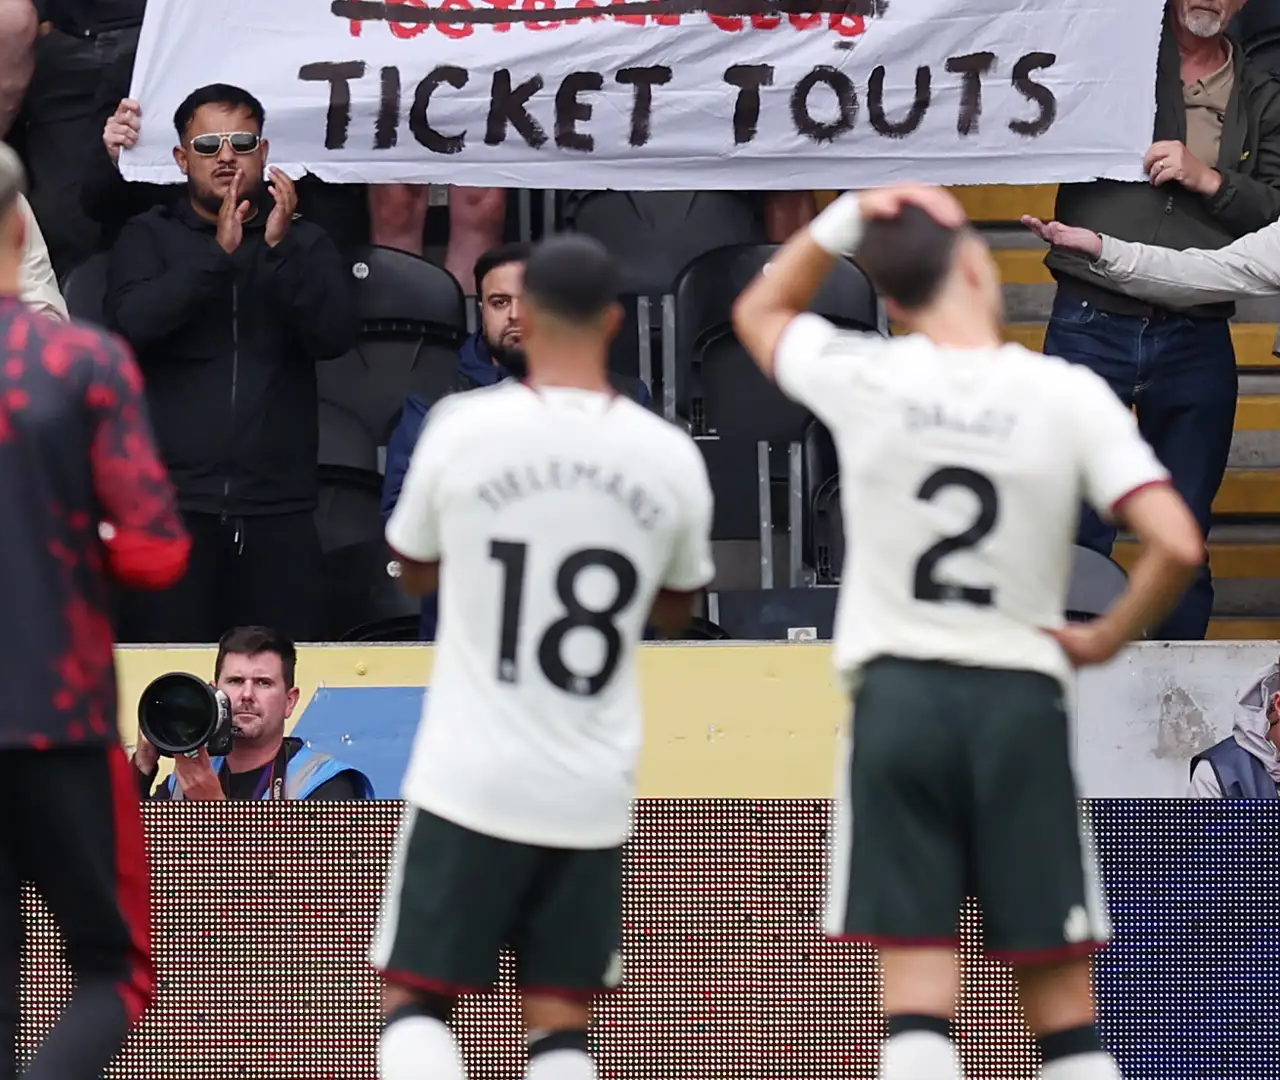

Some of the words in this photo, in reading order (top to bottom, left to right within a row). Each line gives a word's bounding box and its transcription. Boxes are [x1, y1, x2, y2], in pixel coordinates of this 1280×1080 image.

[298, 60, 673, 155] TICKET
[723, 50, 1057, 146] TOUTS
[913, 465, 999, 606] 2
[488, 539, 639, 698] 18
